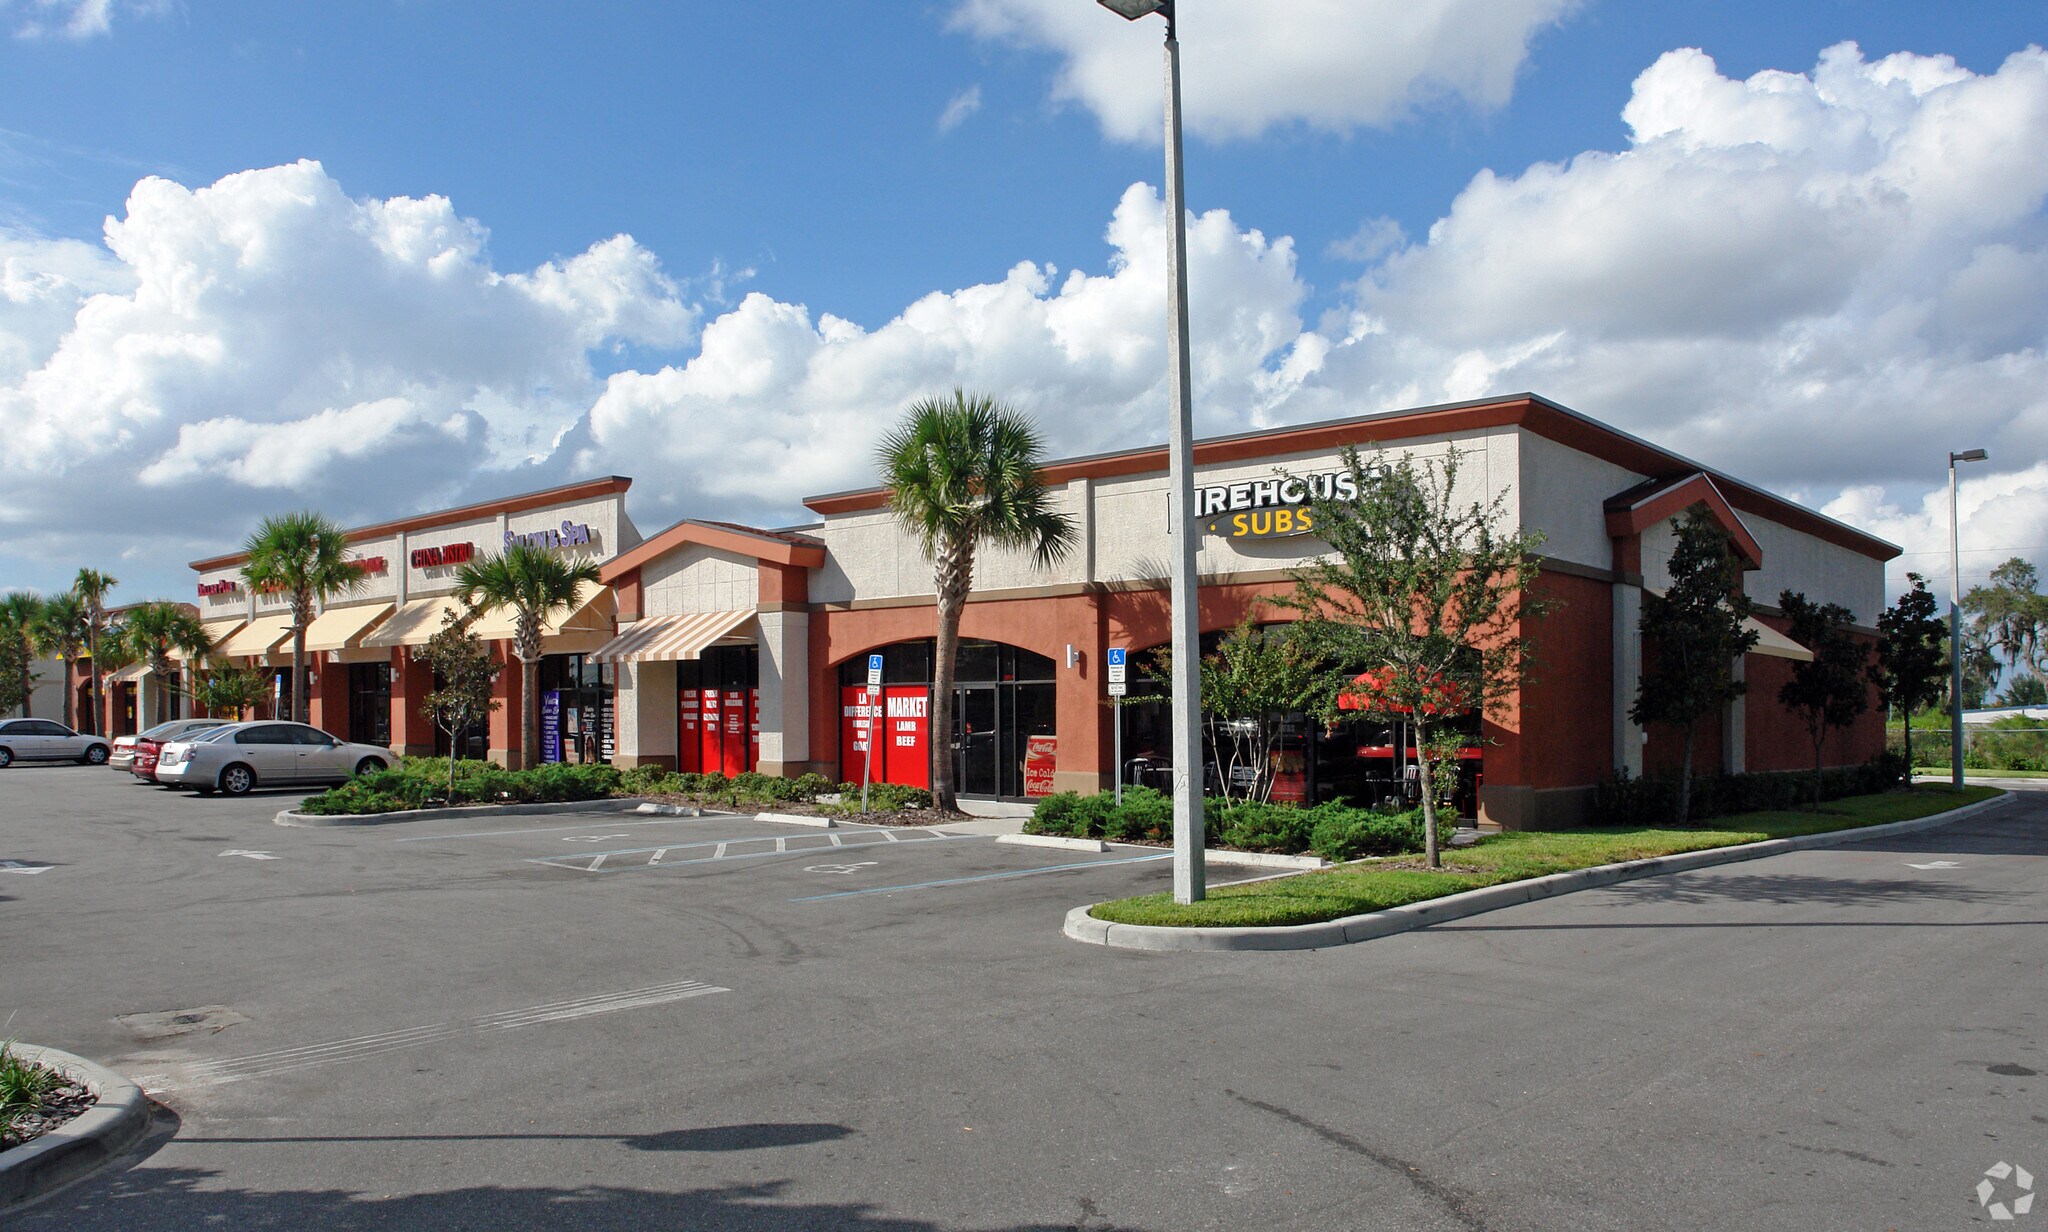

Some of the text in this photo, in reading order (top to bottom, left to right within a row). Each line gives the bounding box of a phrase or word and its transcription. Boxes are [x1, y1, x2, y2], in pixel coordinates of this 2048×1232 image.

[1167, 464, 1390, 534] IREHOUS
[1233, 507, 1312, 537] SUBS
[549, 529, 559, 549] &
[561, 520, 590, 547] SPA
[411, 547, 441, 569] CHINA
[441, 541, 474, 565] BISTRO
[858, 693, 867, 704] LA
[887, 697, 927, 717] MARKET
[844, 706, 882, 717] DIFFERECE
[896, 721, 917, 732] LAMB
[896, 736, 916, 747] BEEF
